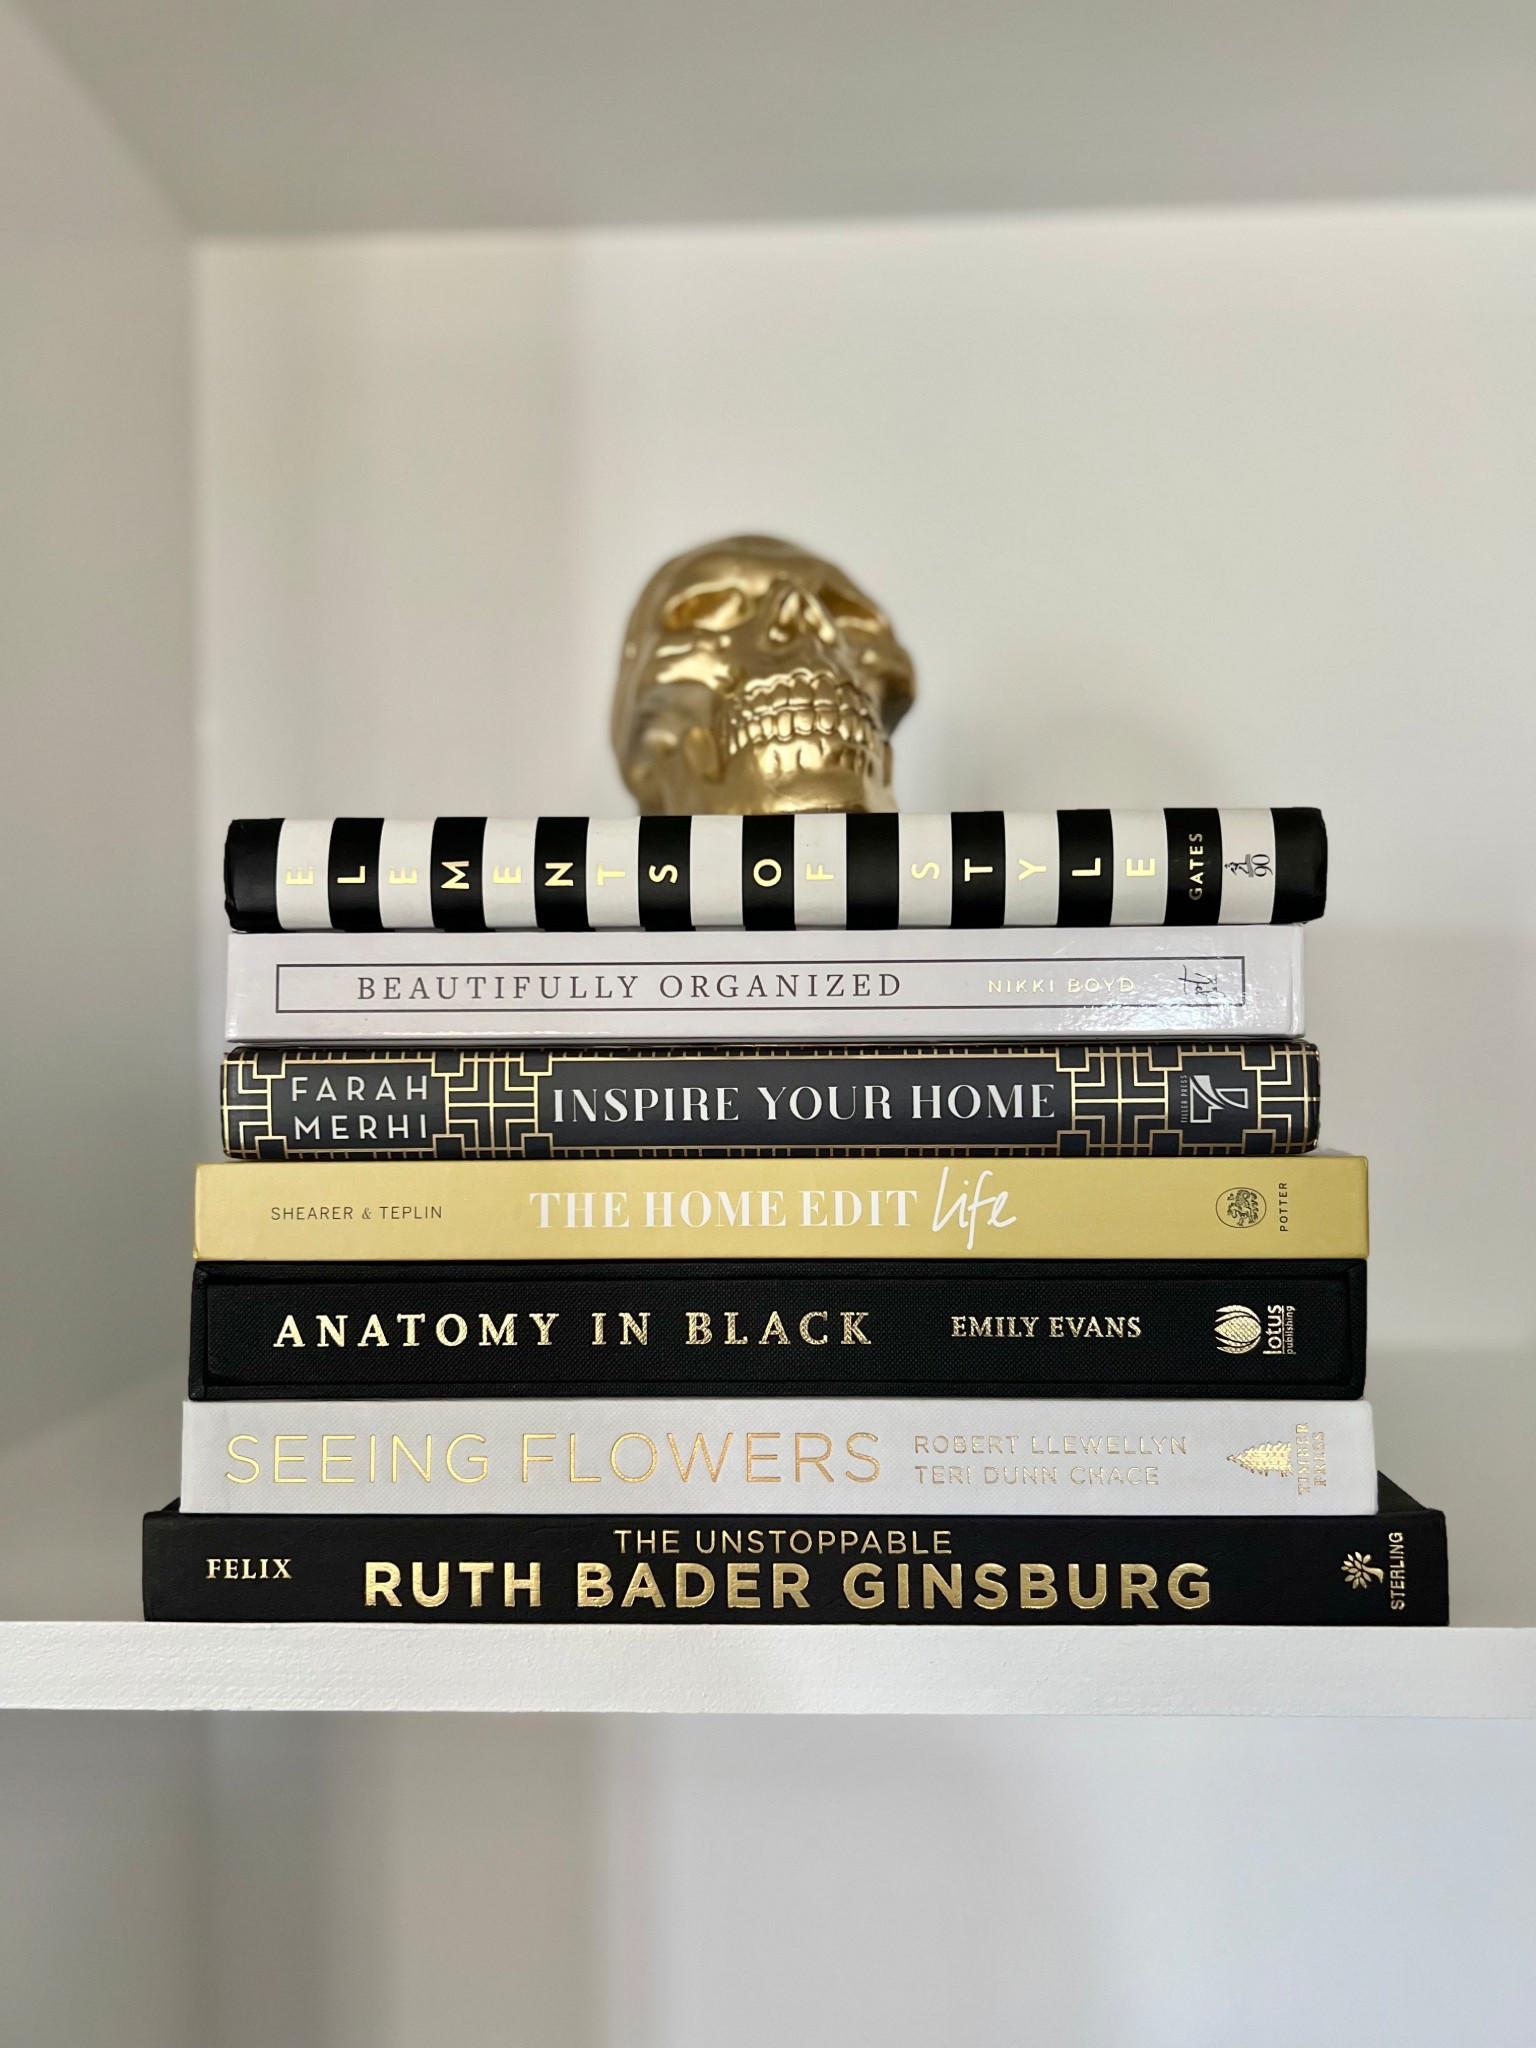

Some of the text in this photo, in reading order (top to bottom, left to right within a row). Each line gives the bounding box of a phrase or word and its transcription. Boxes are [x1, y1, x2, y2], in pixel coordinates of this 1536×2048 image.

[286, 857, 1156, 890] ELEMENTS OF STYLE
[1188, 833, 1204, 900] GATES
[1250, 853, 1274, 878] 90
[357, 973, 901, 1000] BEAUTIFULLY ORGANIZED
[987, 977, 1135, 993] NIKKI BOYD
[291, 1075, 429, 1102] FARAH
[1180, 1074, 1188, 1097] PRESS
[553, 1083, 1056, 1123] INSPIRE YOUR HOME
[294, 1113, 428, 1140] MERHI
[270, 1205, 443, 1221] SHEARER & TEPLIN
[529, 1191, 630, 1229] THE
[642, 1190, 787, 1228] HOME
[799, 1189, 918, 1228] EDIT
[1278, 1182, 1289, 1232] POTTER
[272, 1310, 872, 1347] ANATOMY IN BLACK
[950, 1315, 1142, 1338] EMILY EVANS
[1262, 1304, 1282, 1355] lotus
[1284, 1305, 1297, 1356] publishing
[224, 1431, 882, 1485] SEEING FLOWERS
[914, 1435, 1187, 1456] ROBERT LLEWELLYN
[1296, 1423, 1310, 1495] TIMBER
[1312, 1431, 1326, 1486] PRESS
[914, 1465, 1159, 1485] TERI DUNN CHACE
[613, 1529, 952, 1555] THE UNSTOPPABLE
[205, 1558, 293, 1580] FELIX
[364, 1561, 1212, 1610] RUTH BADER GINSBURG
[1388, 1532, 1406, 1610] STERLING
